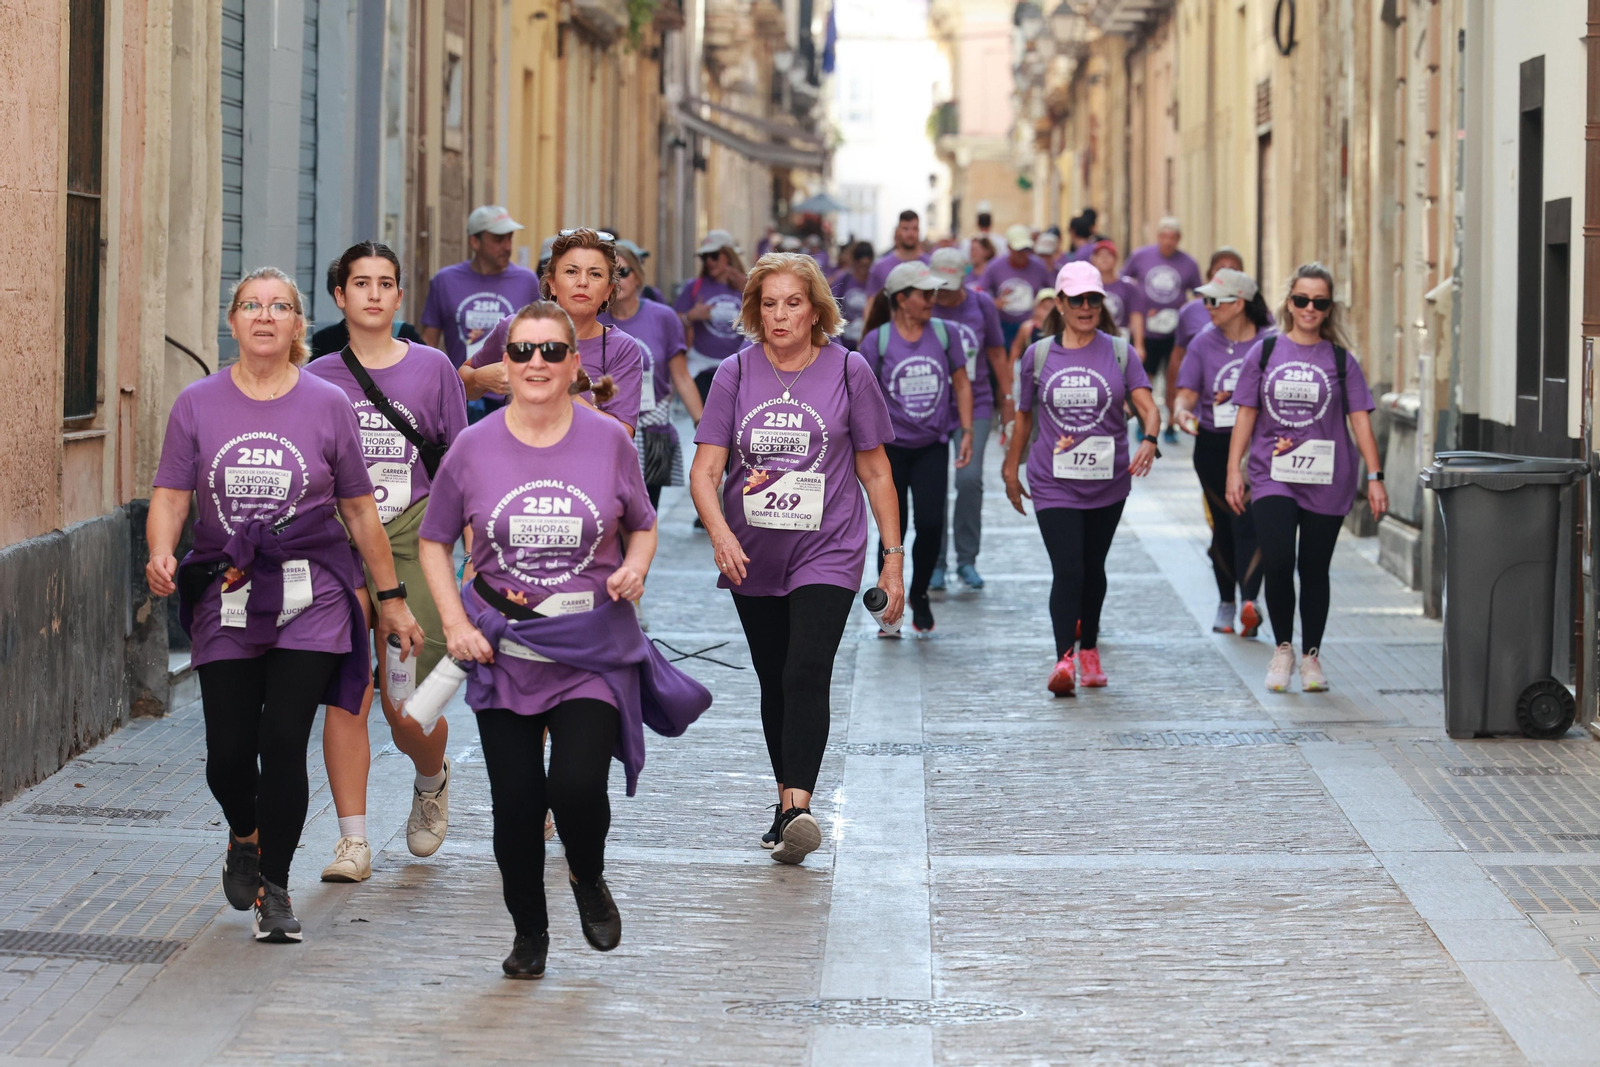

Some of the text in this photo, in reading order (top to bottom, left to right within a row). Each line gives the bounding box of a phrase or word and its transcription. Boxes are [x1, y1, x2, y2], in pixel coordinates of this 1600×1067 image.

[1060, 376, 1090, 387] 25N
[1283, 369, 1314, 381] 25N
[393, 401, 419, 430] CONTRA
[763, 412, 803, 429] 25N
[800, 402, 825, 431] CONTRA
[822, 431, 829, 443] LA
[366, 437, 396, 446] HORAS
[771, 436, 800, 445] HORAS
[211, 431, 278, 469] INTERNACIONAL
[279, 437, 307, 472] CONTRA
[367, 447, 401, 455] 21 21 30
[752, 444, 771, 452] 900
[792, 445, 805, 453] 30
[237, 447, 283, 467] 25N
[1073, 453, 1097, 466] 175
[1292, 455, 1316, 469] 177
[207, 470, 216, 488] DÍA
[234, 475, 280, 485] 24 HORAS
[302, 472, 310, 487] LA
[228, 485, 285, 497] 900 21 21 30
[373, 485, 389, 503] 0
[522, 497, 572, 514] 25N
[763, 491, 802, 511] 269
[378, 505, 404, 513] ASTIMA
[485, 520, 495, 539] DÍA
[490, 479, 565, 519] INTERNACIONAL
[566, 485, 600, 519] CONTRA
[596, 520, 604, 535] LA
[751, 510, 773, 518] ROMPE
[781, 512, 812, 520] SILENCIO
[520, 524, 570, 533] 24 HORAS
[513, 535, 576, 545] 900 21 21 30
[519, 573, 540, 586] LAS
[540, 572, 571, 586] HACIA
